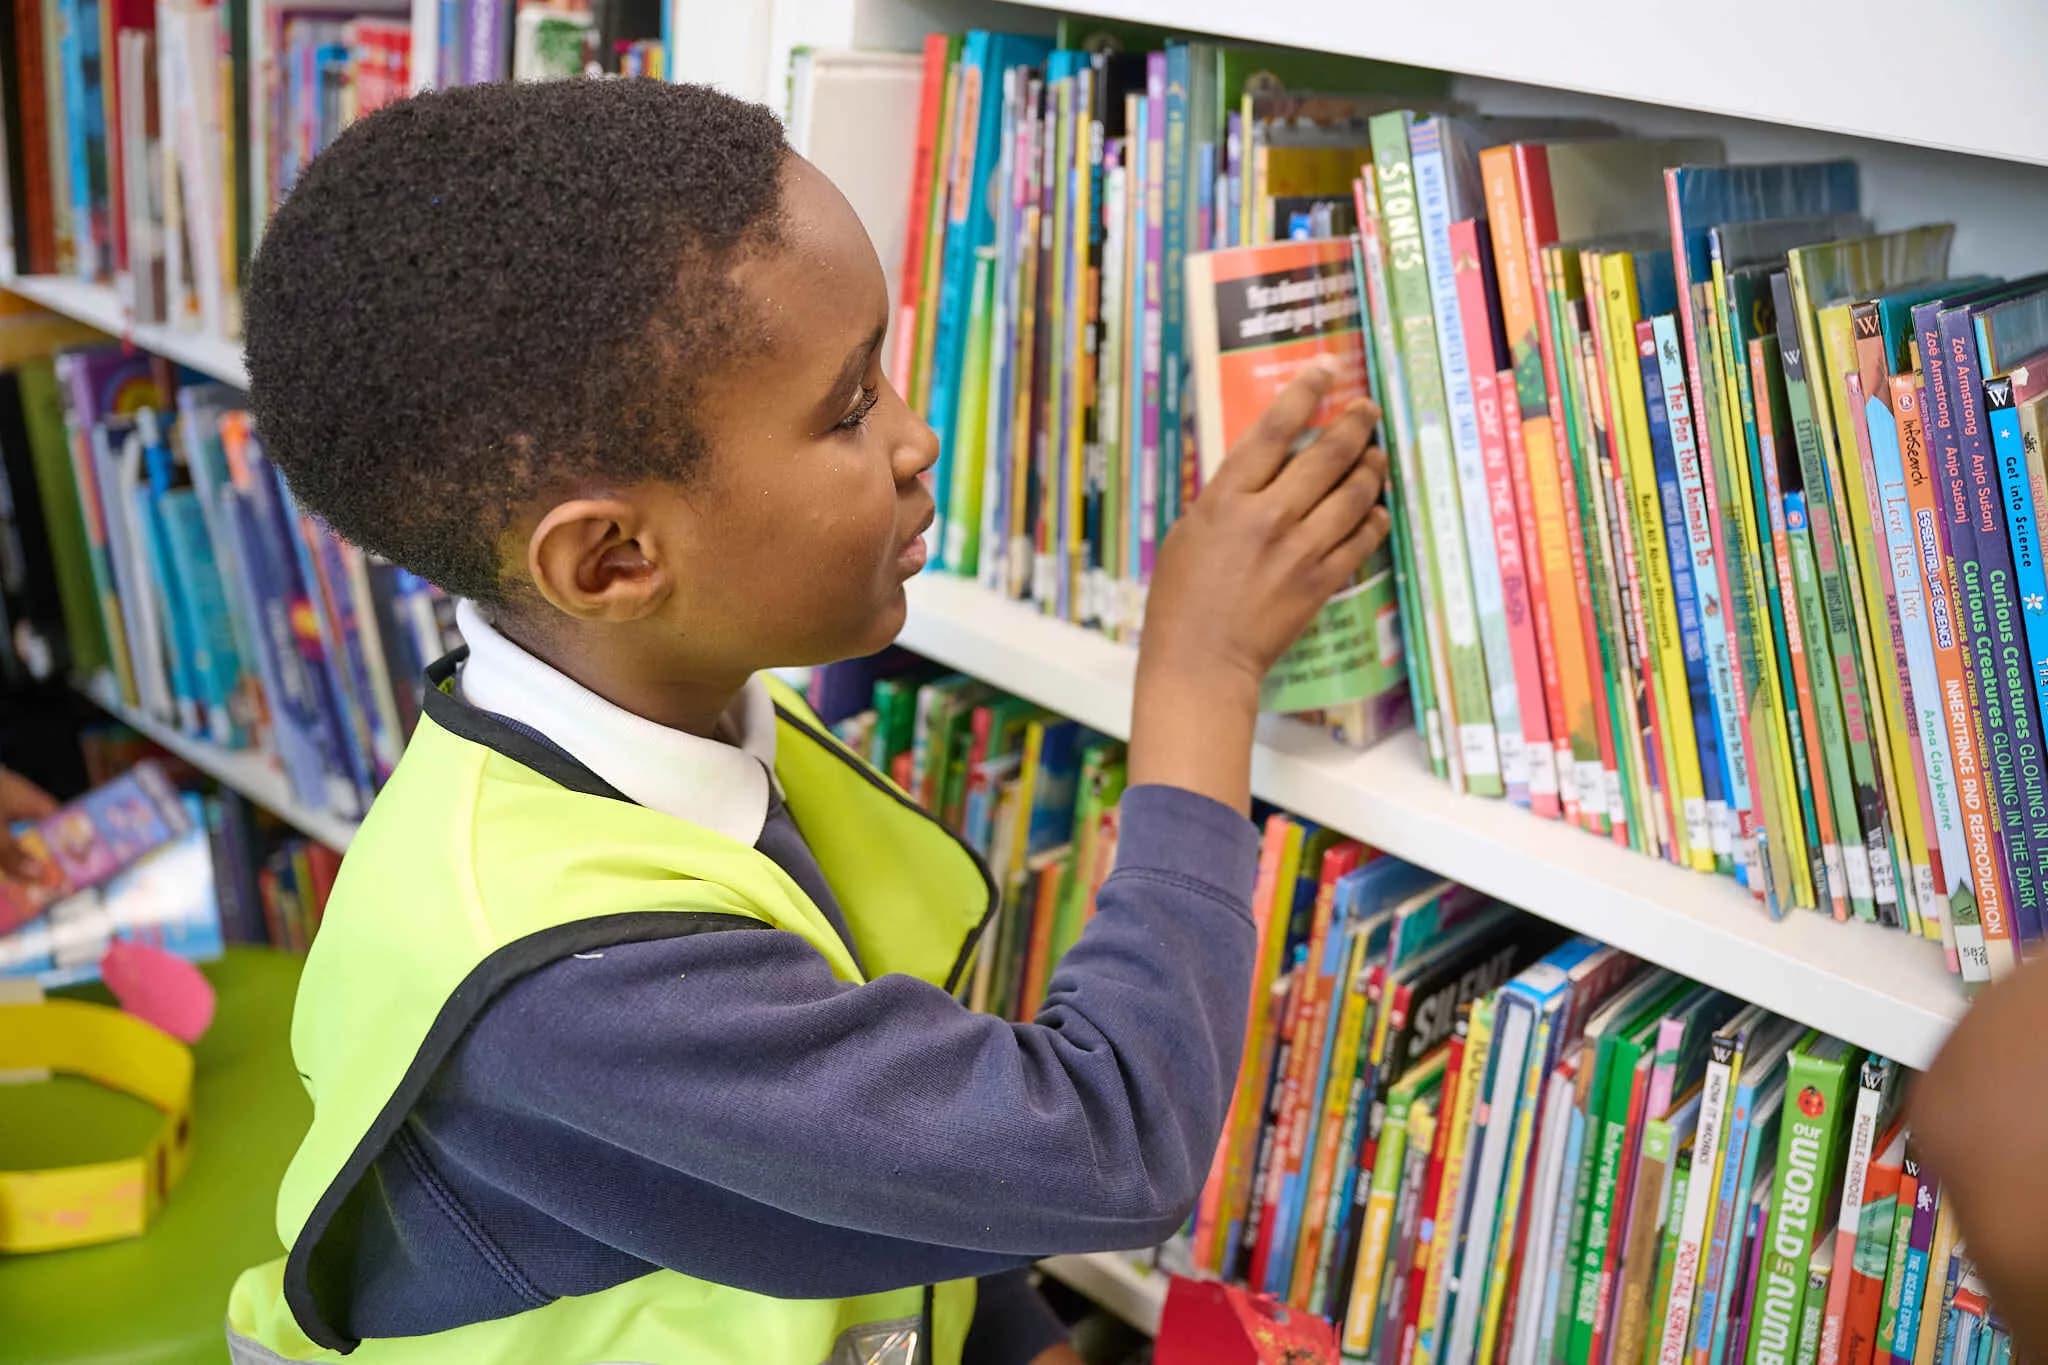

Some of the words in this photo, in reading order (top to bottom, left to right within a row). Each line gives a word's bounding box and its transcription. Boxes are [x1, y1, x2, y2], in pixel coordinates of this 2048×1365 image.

[1377, 160, 1423, 272] STONES
[1855, 314, 1881, 337] W
[1925, 330, 1940, 356] Zoë
[1783, 348, 1802, 365] W
[1951, 336, 1967, 362] Zoë
[1475, 374, 1494, 392] A
[1668, 382, 1688, 412] The
[1927, 358, 1952, 428] Armstrong
[1952, 364, 1980, 436] Armstrong
[1987, 386, 2012, 408] W
[1477, 397, 1501, 439] DAY
[1673, 416, 1693, 443] Poo
[1484, 446, 1504, 467] IN
[1678, 445, 1699, 480] that
[1943, 445, 1961, 476] Anja
[1969, 452, 1989, 484] Anja
[2002, 456, 2019, 480] Get
[1488, 475, 1511, 515] THE
[1882, 480, 1904, 491] I
[1948, 478, 1970, 524] Sušanj
[2008, 484, 2026, 512] into
[1640, 492, 1655, 526] Read
[1684, 485, 1709, 543] Animals
[1884, 495, 1911, 535] Love
[1974, 486, 1998, 533] Sušanj
[1495, 523, 1518, 566] LIFE
[1694, 548, 1713, 567] Do
[1893, 541, 1920, 578] This
[1916, 508, 1941, 573] ESSENTIAL
[2012, 515, 2036, 568] Science
[1648, 545, 1664, 584] About
[1823, 575, 1848, 634] DINOSAURS
[1898, 582, 1926, 620] Tree
[1926, 573, 1944, 597] LIFE
[1943, 555, 1968, 642] ANKYLOSAURUS
[1961, 559, 1989, 633] Curious
[1653, 586, 1674, 650] Dinosaurs
[1885, 593, 1899, 621] PLANT
[1931, 596, 1954, 649] SCIENCE
[1987, 569, 2017, 643] Curious
[1725, 631, 1739, 663] Steve
[1890, 623, 1904, 649] CELLS
[1895, 651, 1908, 669] AND
[1959, 644, 1972, 668] AND
[1713, 642, 1727, 663] Paul
[1721, 696, 1735, 712] and
[1899, 670, 1911, 687] LIFE
[1964, 669, 1979, 706] OTHER
[1974, 635, 2005, 728] Creatures
[2001, 645, 2034, 739] Creatures
[1903, 689, 1920, 737] PROCESSES
[1922, 707, 1940, 746] Anna
[1944, 678, 1976, 776] INHERITANCE
[1971, 707, 1991, 774] ARMOURED
[1991, 731, 2019, 806] GLOWING
[2017, 743, 2047, 819] GLOWING
[1926, 749, 1956, 833] Claybourne
[1961, 776, 1981, 810] AND
[1983, 775, 2002, 832] DINOSAURS
[2005, 809, 2022, 827] IN
[2031, 821, 2048, 839] IN
[2009, 832, 2028, 861] THE
[1967, 812, 2004, 934] REPRODUCTION
[2014, 865, 2037, 910] DARK
[1711, 1044, 1731, 1064] W
[1863, 1072, 1881, 1090] W
[1705, 1105, 1718, 1118] IT
[1854, 1113, 1871, 1157] PUZZLE
[1594, 1121, 1624, 1209] Interview
[1846, 1160, 1864, 1207] HEROES
[1905, 1159, 1920, 1176] W
[1773, 1136, 1820, 1260] WORLD
[1670, 1240, 1699, 1300] POSTAL
